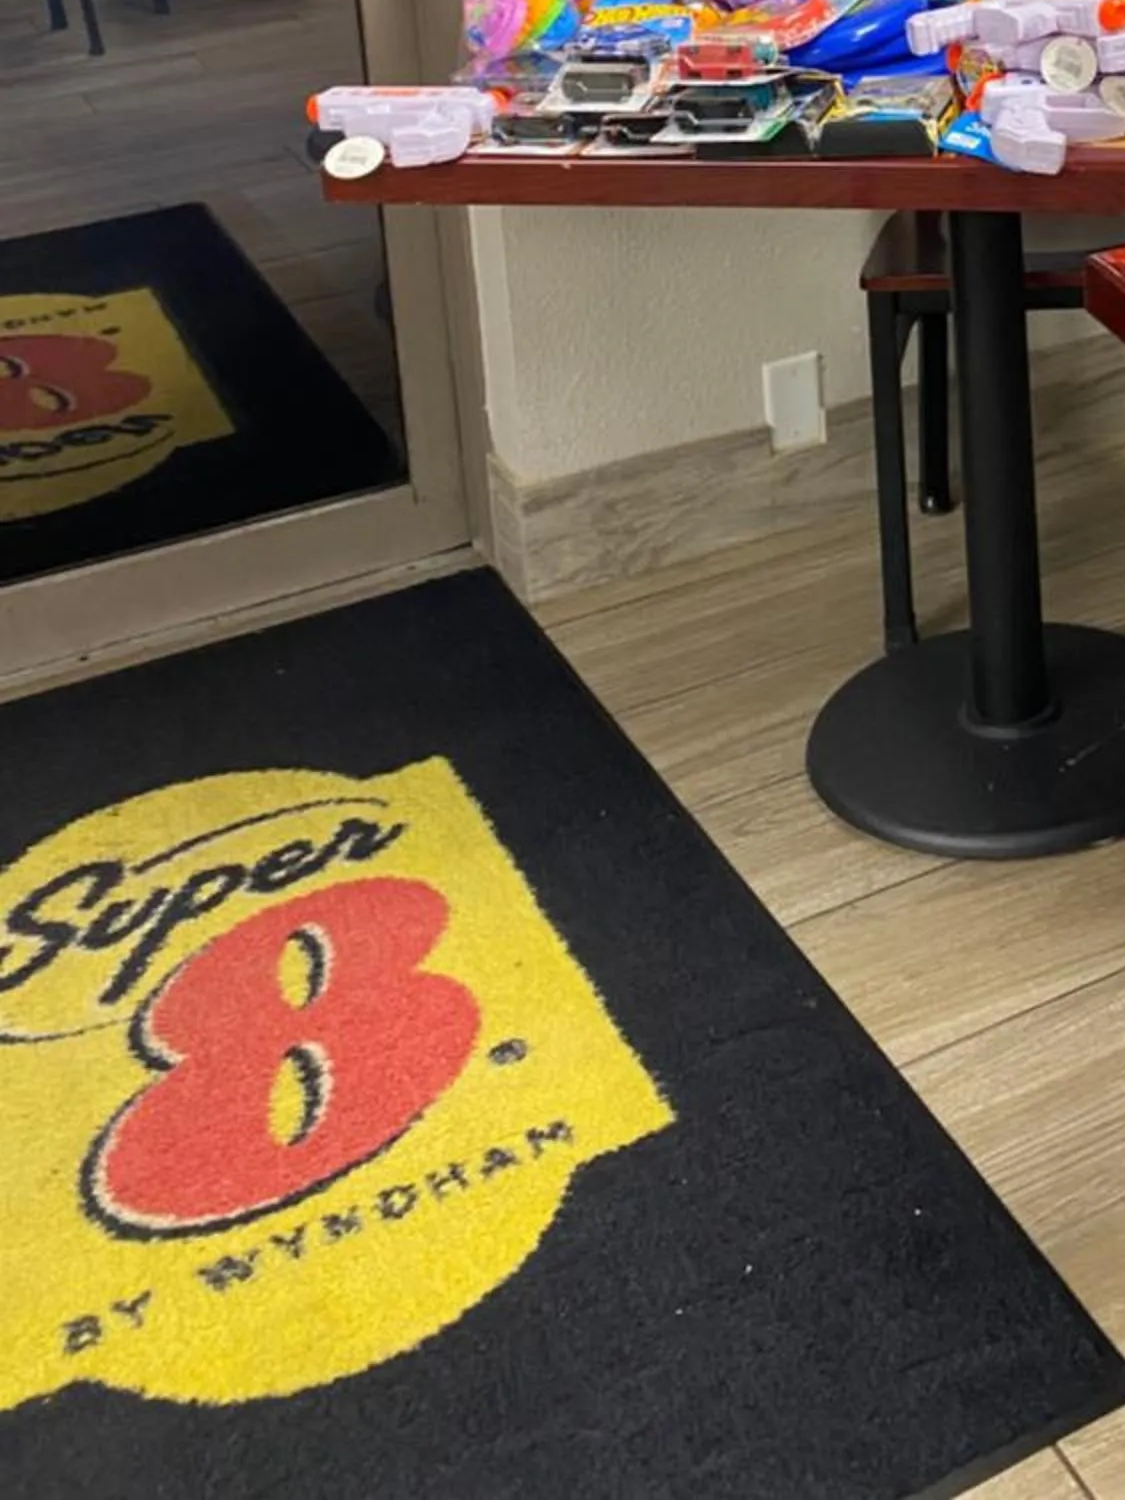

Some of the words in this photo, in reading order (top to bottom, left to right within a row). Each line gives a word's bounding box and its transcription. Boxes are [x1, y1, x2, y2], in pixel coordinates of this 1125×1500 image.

[0, 816, 407, 1006] Super
[78, 876, 482, 1242] 8
[62, 1289, 154, 1355] BY
[196, 1119, 575, 1293] WYNDHAM
